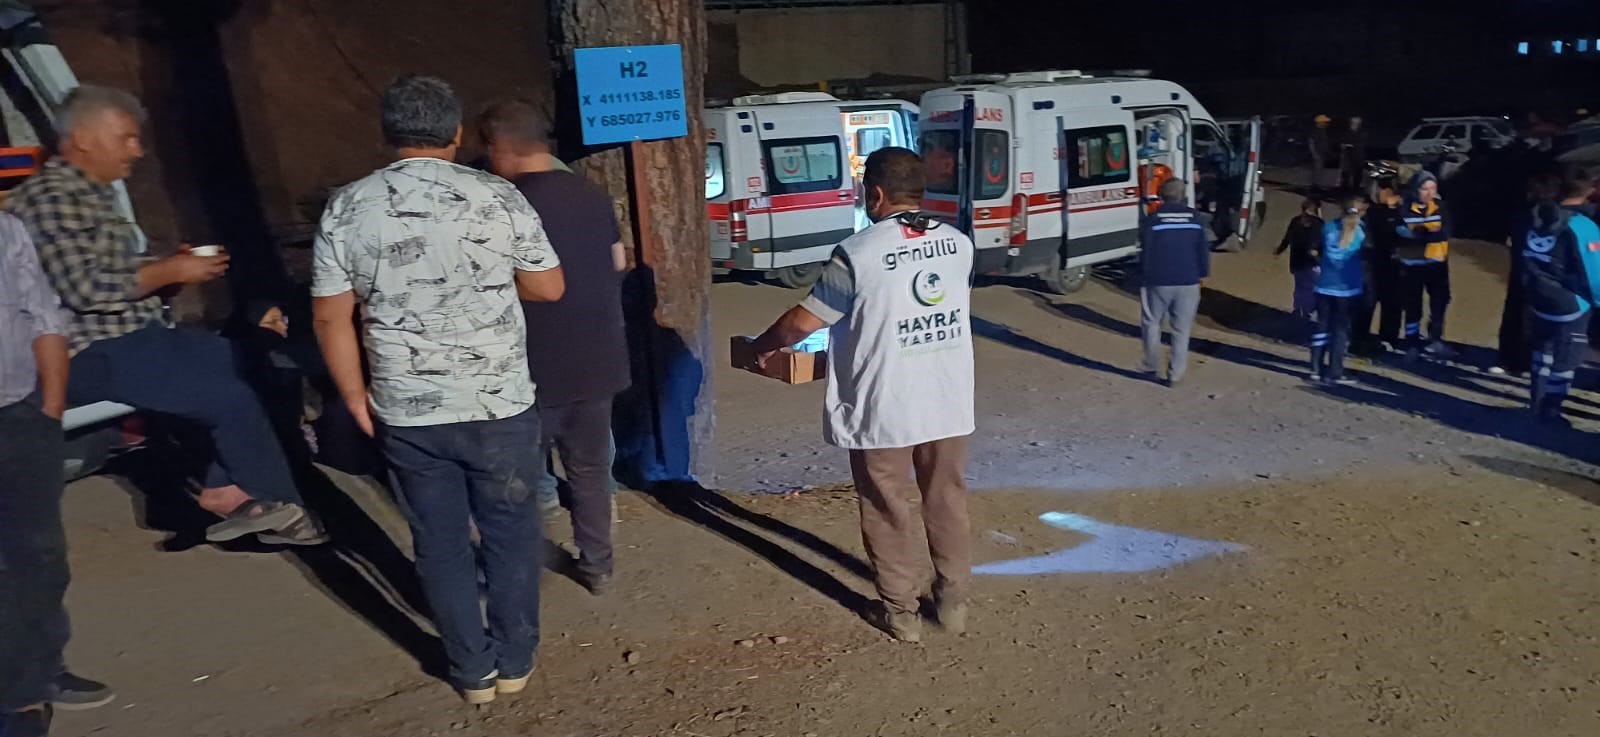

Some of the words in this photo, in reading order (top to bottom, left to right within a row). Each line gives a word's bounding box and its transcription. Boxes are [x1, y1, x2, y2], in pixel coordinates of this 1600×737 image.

[619, 61, 649, 79] H2
[582, 94, 593, 106] X
[599, 88, 681, 105] 4111138.185
[586, 116, 596, 128] Y
[601, 110, 681, 127] 685027.976
[884, 237, 957, 271] gönüllü
